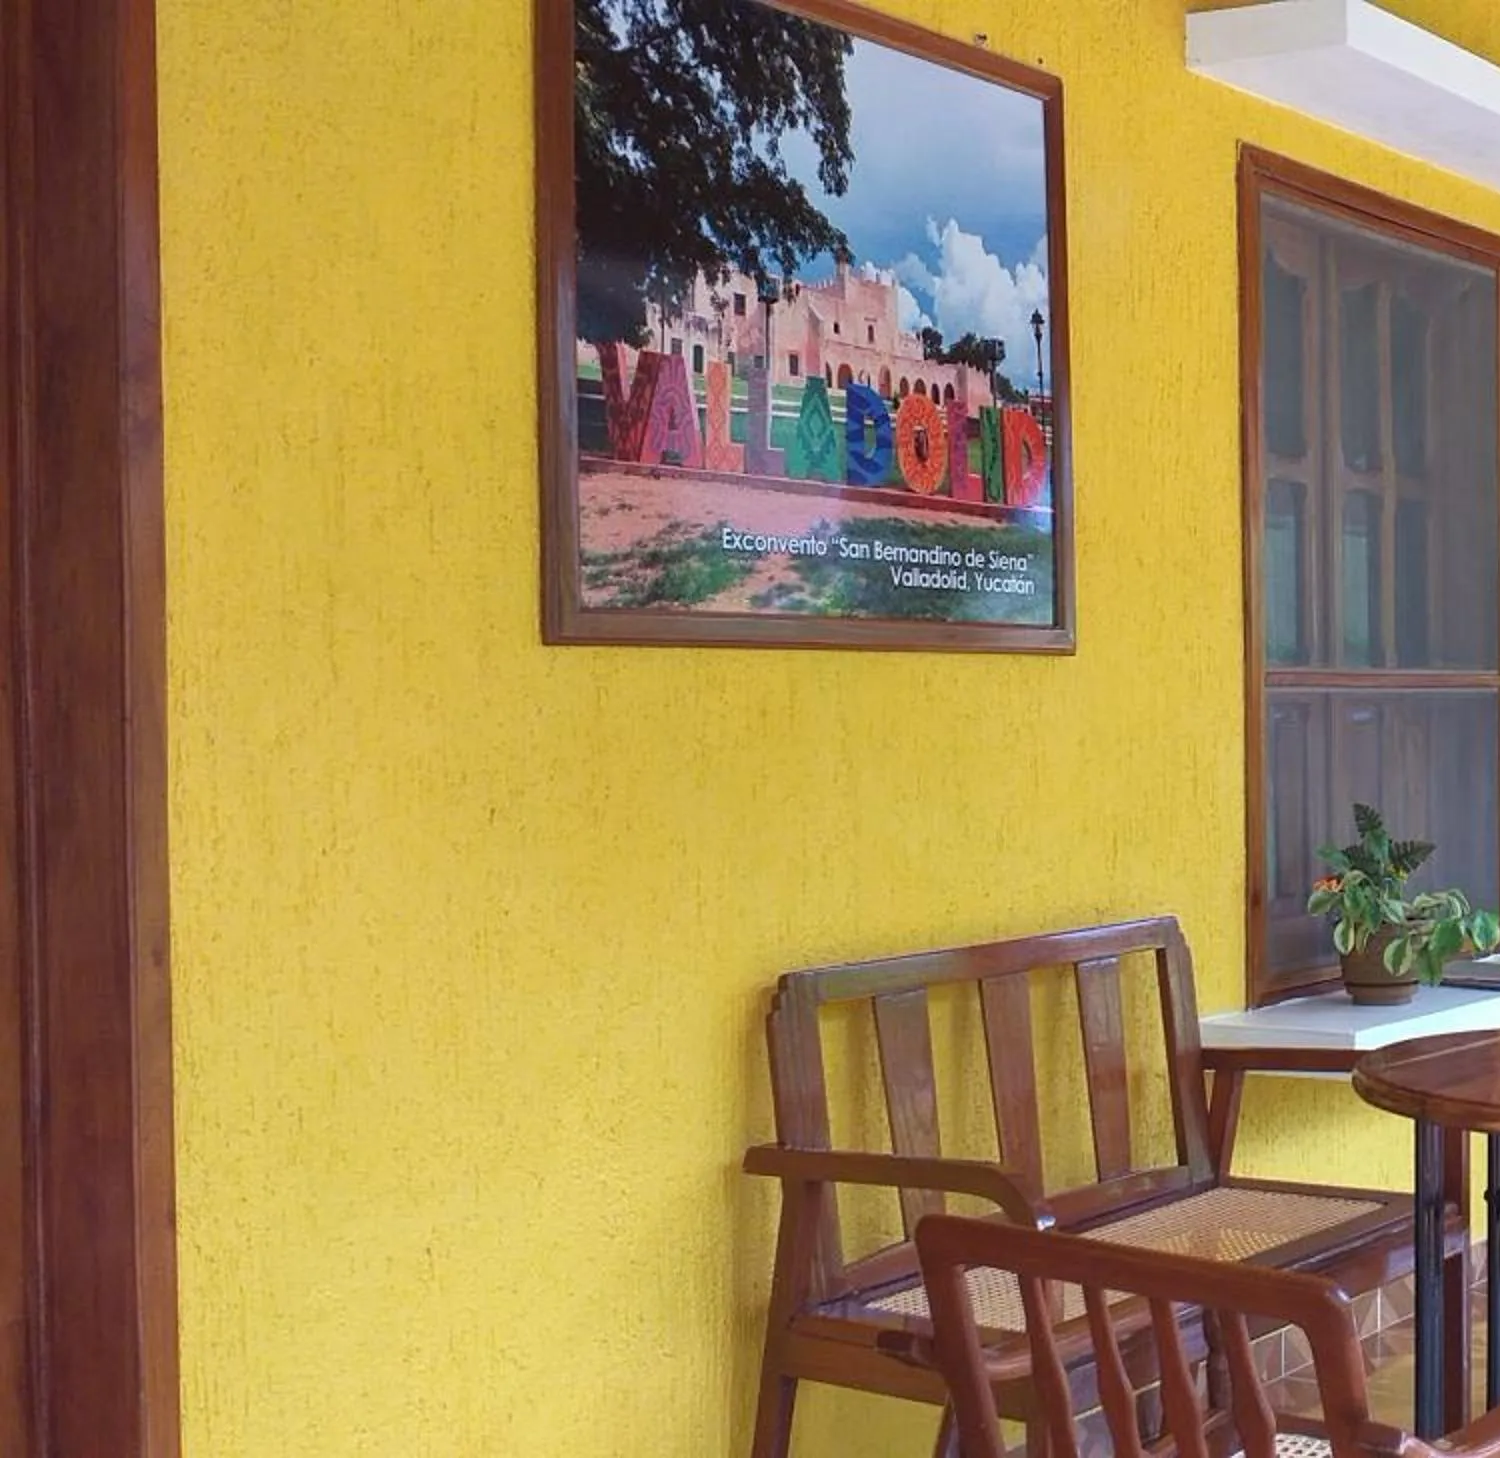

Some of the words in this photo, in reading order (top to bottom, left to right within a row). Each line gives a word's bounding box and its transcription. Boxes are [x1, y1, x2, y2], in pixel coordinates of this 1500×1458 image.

[601, 342, 1049, 506] VALLADOLID
[723, 527, 828, 556] Exconvento
[873, 540, 962, 568] Bernandino
[965, 548, 986, 569] de
[974, 571, 1036, 596] Yucatán
